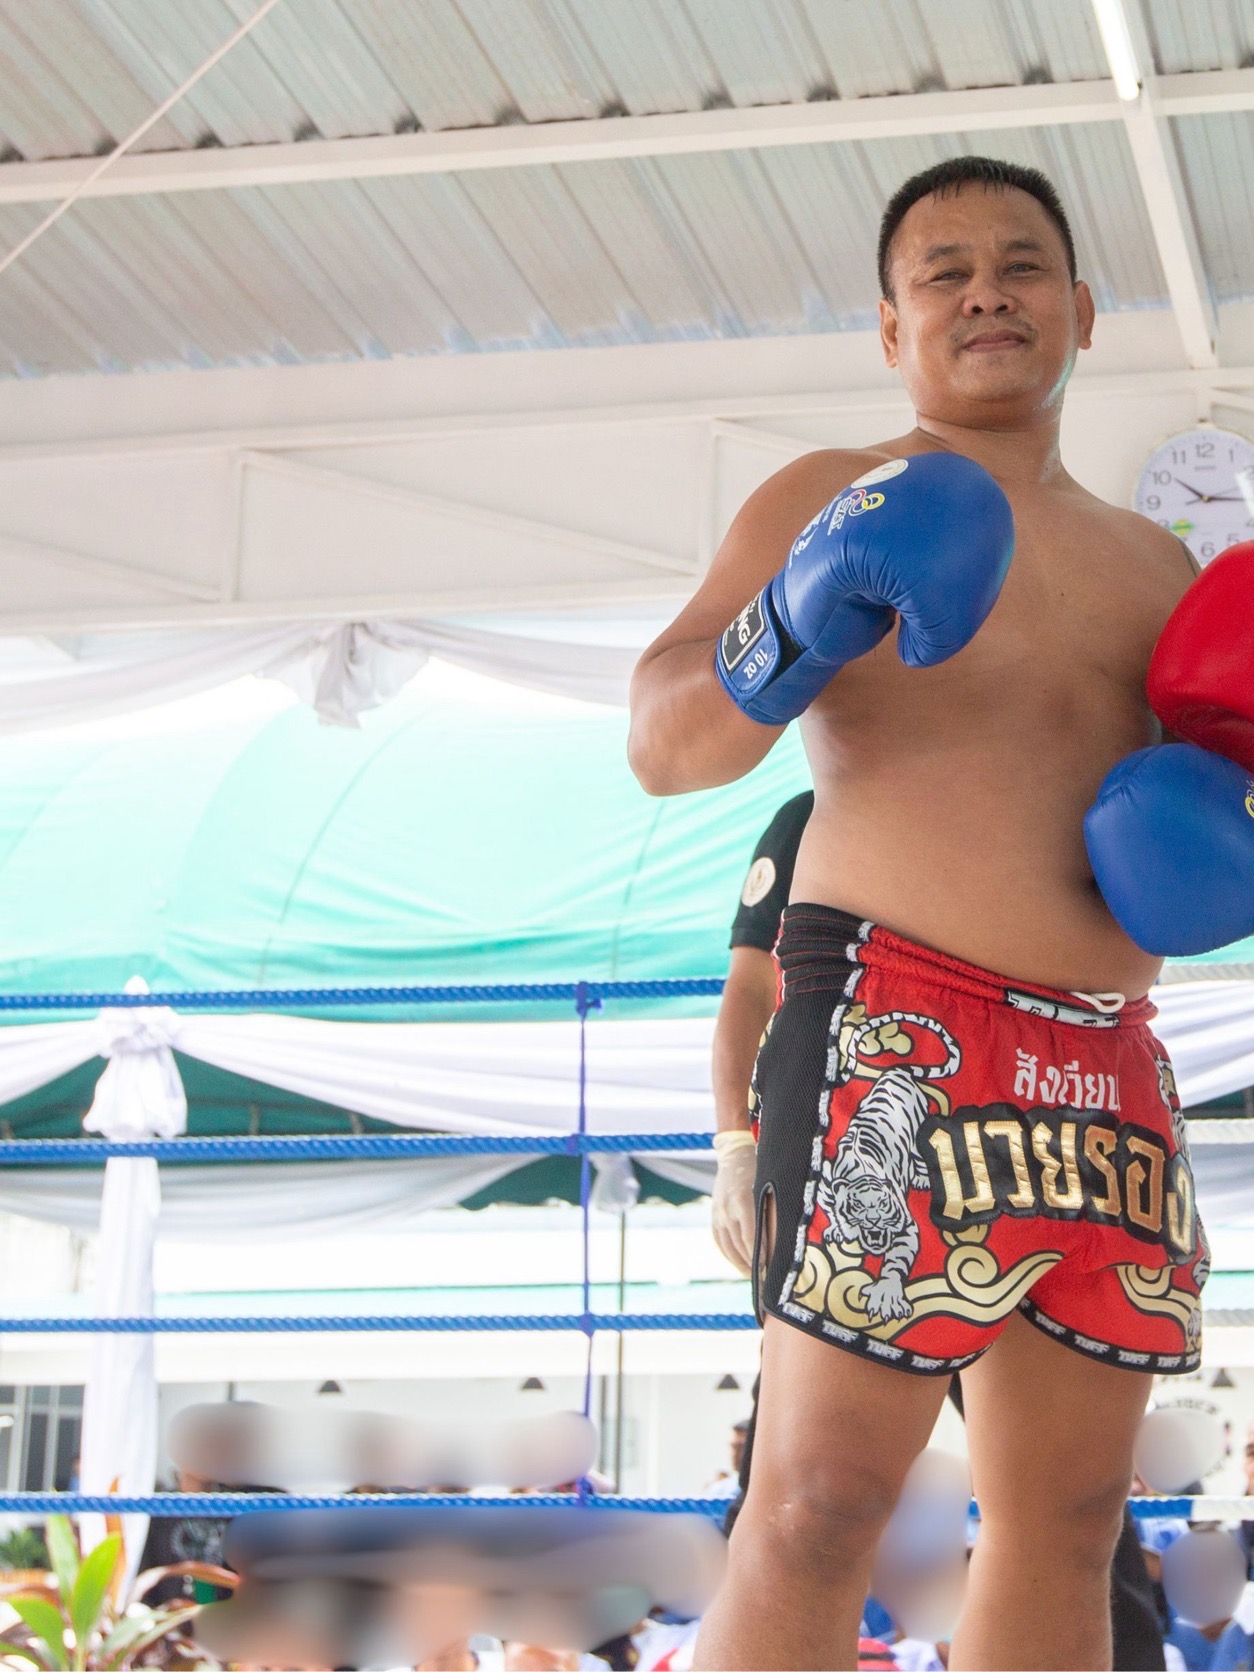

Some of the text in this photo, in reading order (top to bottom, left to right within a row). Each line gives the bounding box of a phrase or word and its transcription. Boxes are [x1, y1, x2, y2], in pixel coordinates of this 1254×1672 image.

[1172, 450, 1187, 465] 11
[1195, 442, 1215, 458] 12
[1228, 448, 1235, 462] 1
[1152, 470, 1172, 486] 10
[1146, 494, 1161, 510] 9
[1227, 533, 1240, 547] 5
[1200, 541, 1215, 558] 6
[754, 648, 768, 667] 10
